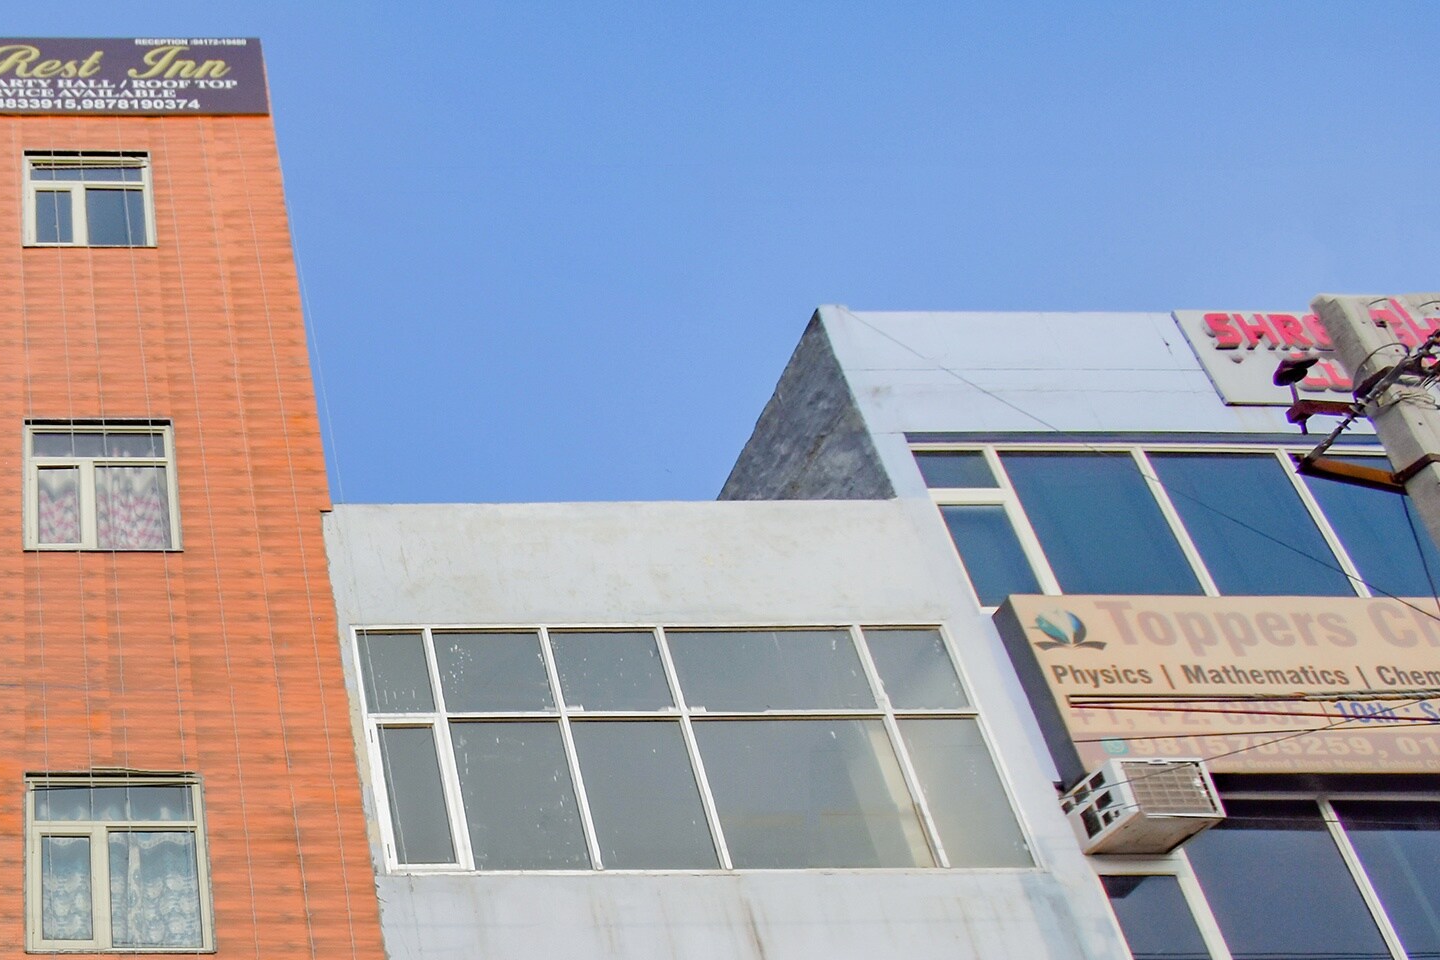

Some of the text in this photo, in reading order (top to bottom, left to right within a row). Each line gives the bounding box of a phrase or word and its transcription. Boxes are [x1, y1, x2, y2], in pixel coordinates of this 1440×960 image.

[135, 38, 188, 46] RECEPTION
[127, 46, 231, 79] Inn
[57, 79, 116, 89] HALL
[131, 79, 191, 89] ROOF
[194, 80, 238, 89] TOP
[58, 88, 177, 98] AVAILABLE
[1094, 600, 1358, 658] Toppers
[1050, 663, 1153, 689] Physics
[1180, 663, 1350, 686] Mathematics
[1333, 701, 1399, 724] 10th
[1418, 701, 1440, 725] S
